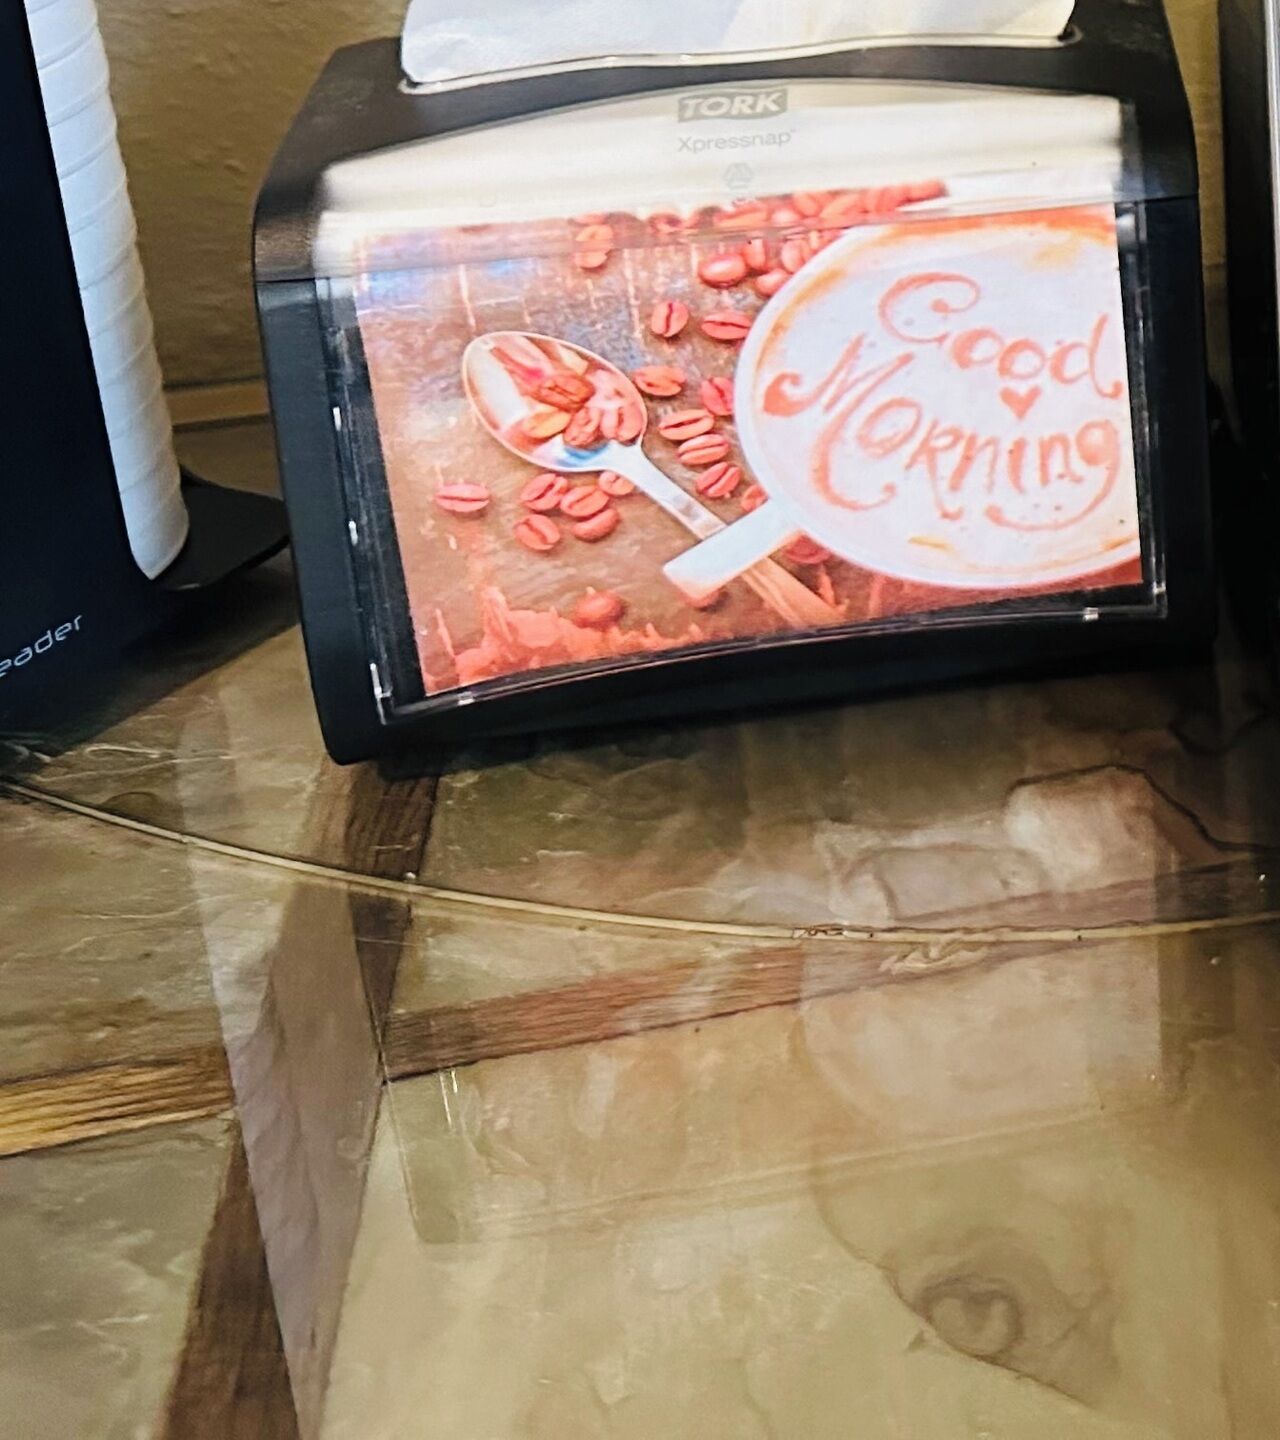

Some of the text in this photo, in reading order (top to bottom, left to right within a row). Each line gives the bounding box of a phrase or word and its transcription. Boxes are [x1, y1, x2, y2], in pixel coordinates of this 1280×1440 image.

[682, 92, 782, 117] TORK
[677, 131, 792, 154] Xpressnap
[878, 272, 1123, 399] Good
